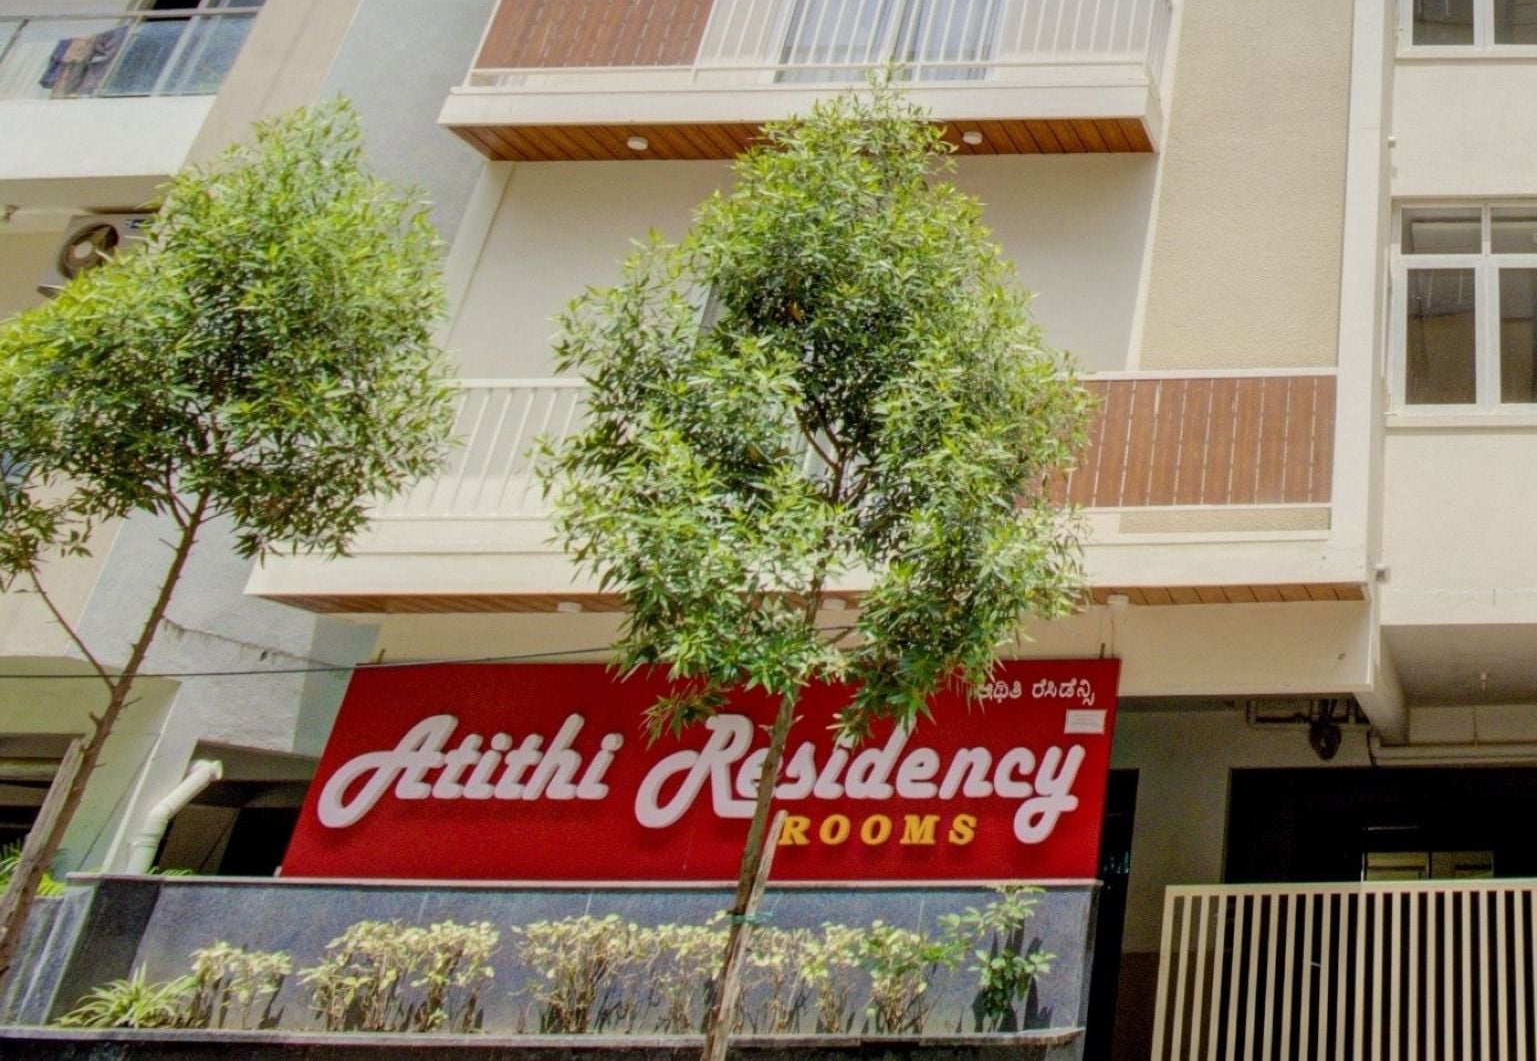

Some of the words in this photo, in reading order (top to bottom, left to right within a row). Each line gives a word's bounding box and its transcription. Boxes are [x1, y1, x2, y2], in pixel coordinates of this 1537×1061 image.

[317, 713, 624, 828] Atithi
[635, 714, 1086, 844] Residency
[777, 814, 978, 845] ROOMS
